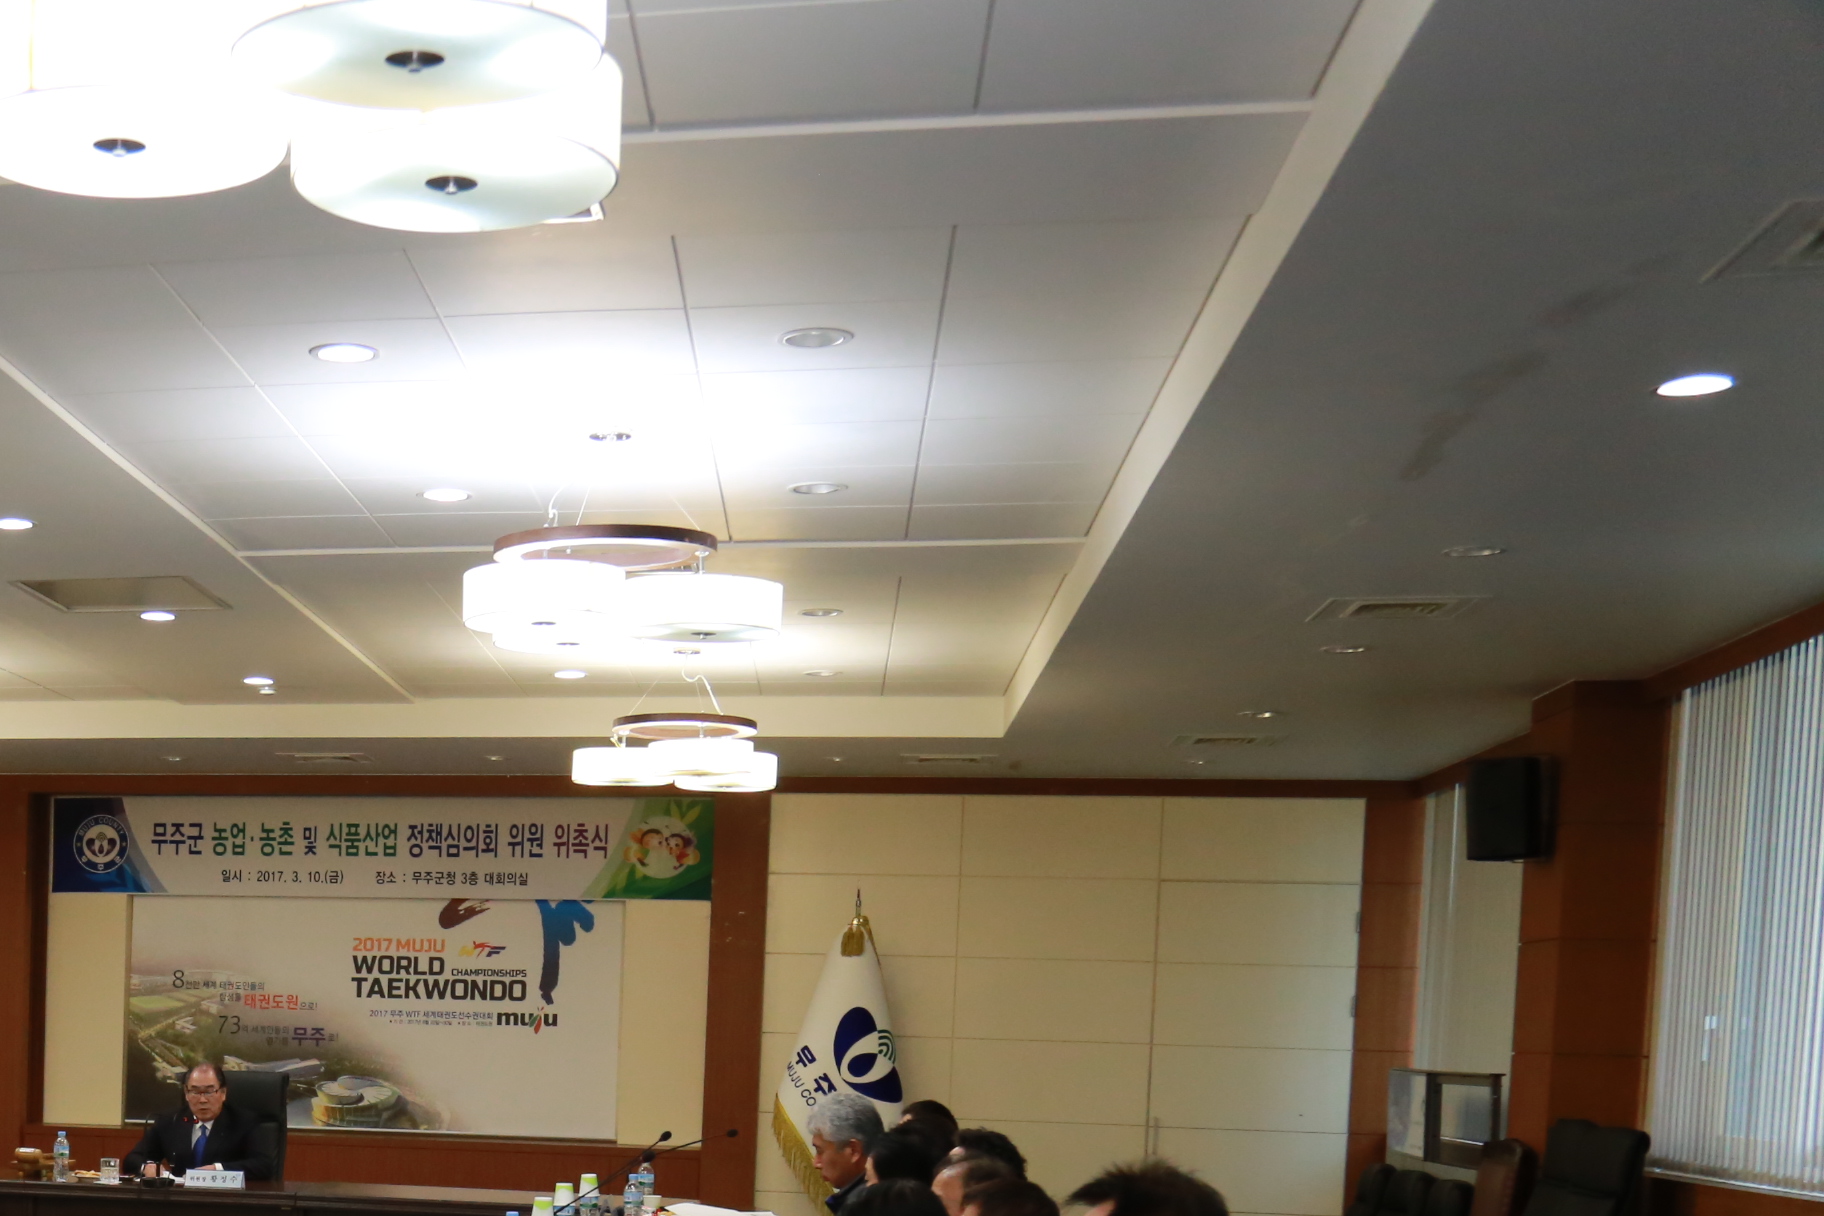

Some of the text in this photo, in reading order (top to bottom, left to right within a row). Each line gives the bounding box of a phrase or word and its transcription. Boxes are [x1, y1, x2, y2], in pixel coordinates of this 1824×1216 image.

[79, 817, 125, 836] MUJU COUNTY
[151, 822, 204, 856] 무주군
[303, 825, 318, 856] 및
[325, 822, 398, 857] 식품산업
[407, 822, 499, 859] 정책심의회
[507, 822, 544, 858] 위원
[552, 822, 609, 860] 위촉식
[221, 869, 243, 884] 일시
[257, 871, 286, 883] 2017.
[292, 871, 303, 883] 3.
[375, 871, 397, 885] 장소
[412, 872, 457, 886] 무주군청
[461, 872, 479, 886] 3층
[484, 872, 529, 887] 대회의실
[352, 937, 446, 954] 2017 MUJU
[351, 954, 528, 979] WORLD CHAMPIONSHIPS
[350, 976, 528, 1002] TAEKWONDO
[369, 1010, 388, 1018] 2017
[787, 1061, 805, 1088] MUJU
